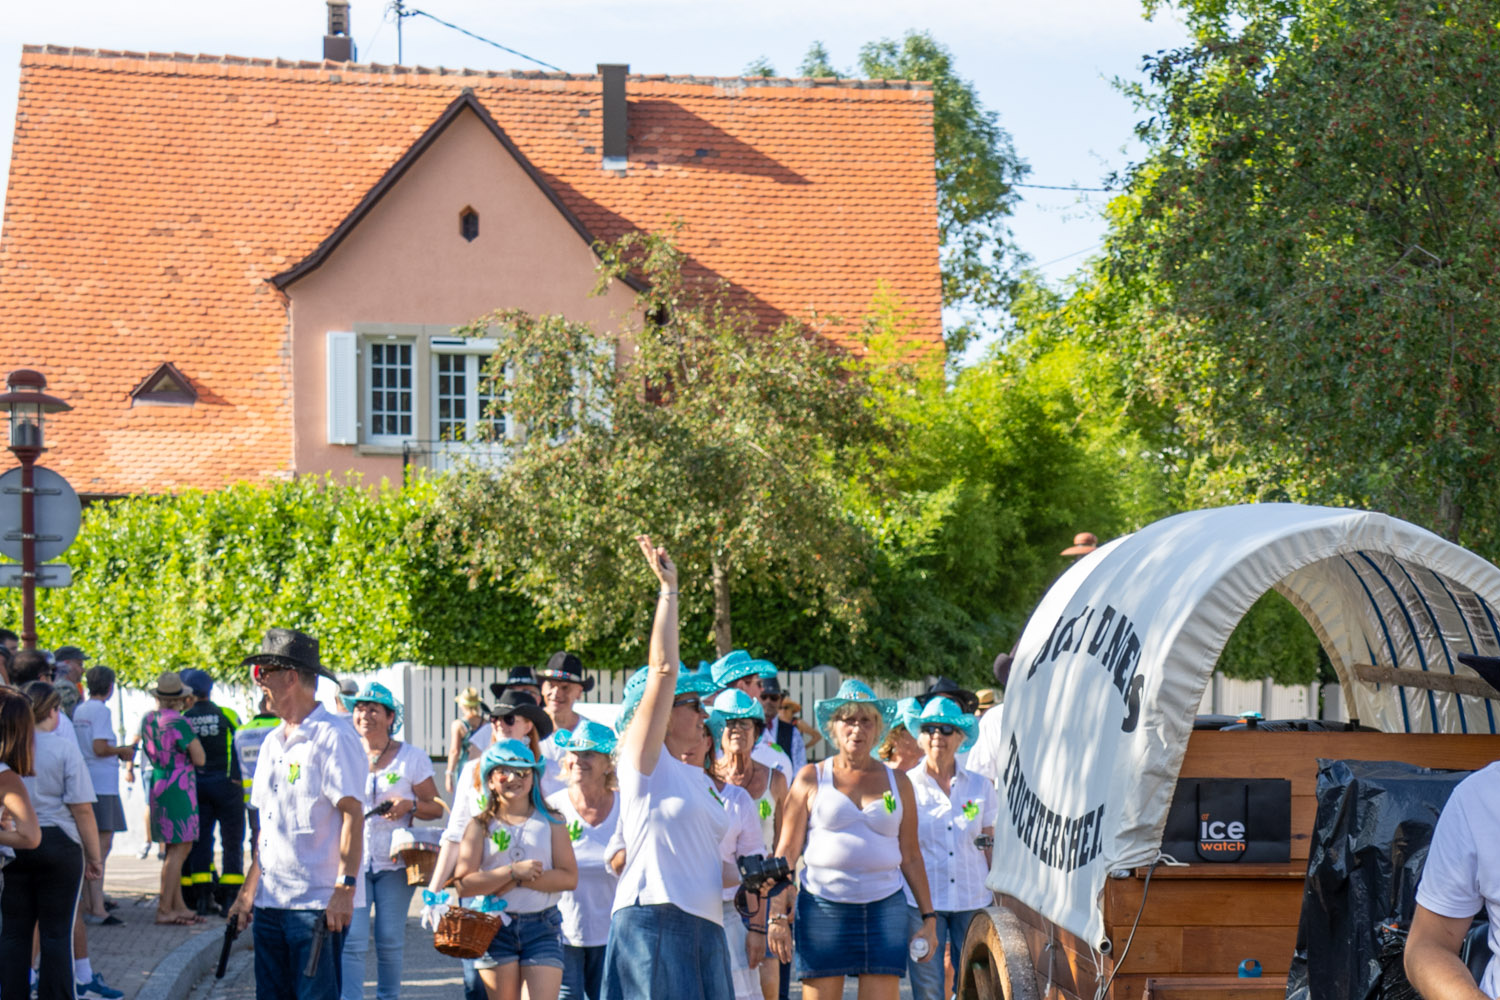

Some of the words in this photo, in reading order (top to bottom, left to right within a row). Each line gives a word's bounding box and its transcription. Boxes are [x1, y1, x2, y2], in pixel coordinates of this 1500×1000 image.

[1003, 731, 1105, 874] TRUCHTERSHEI
[1201, 817, 1246, 839] ice
[1201, 841, 1246, 851] watch
